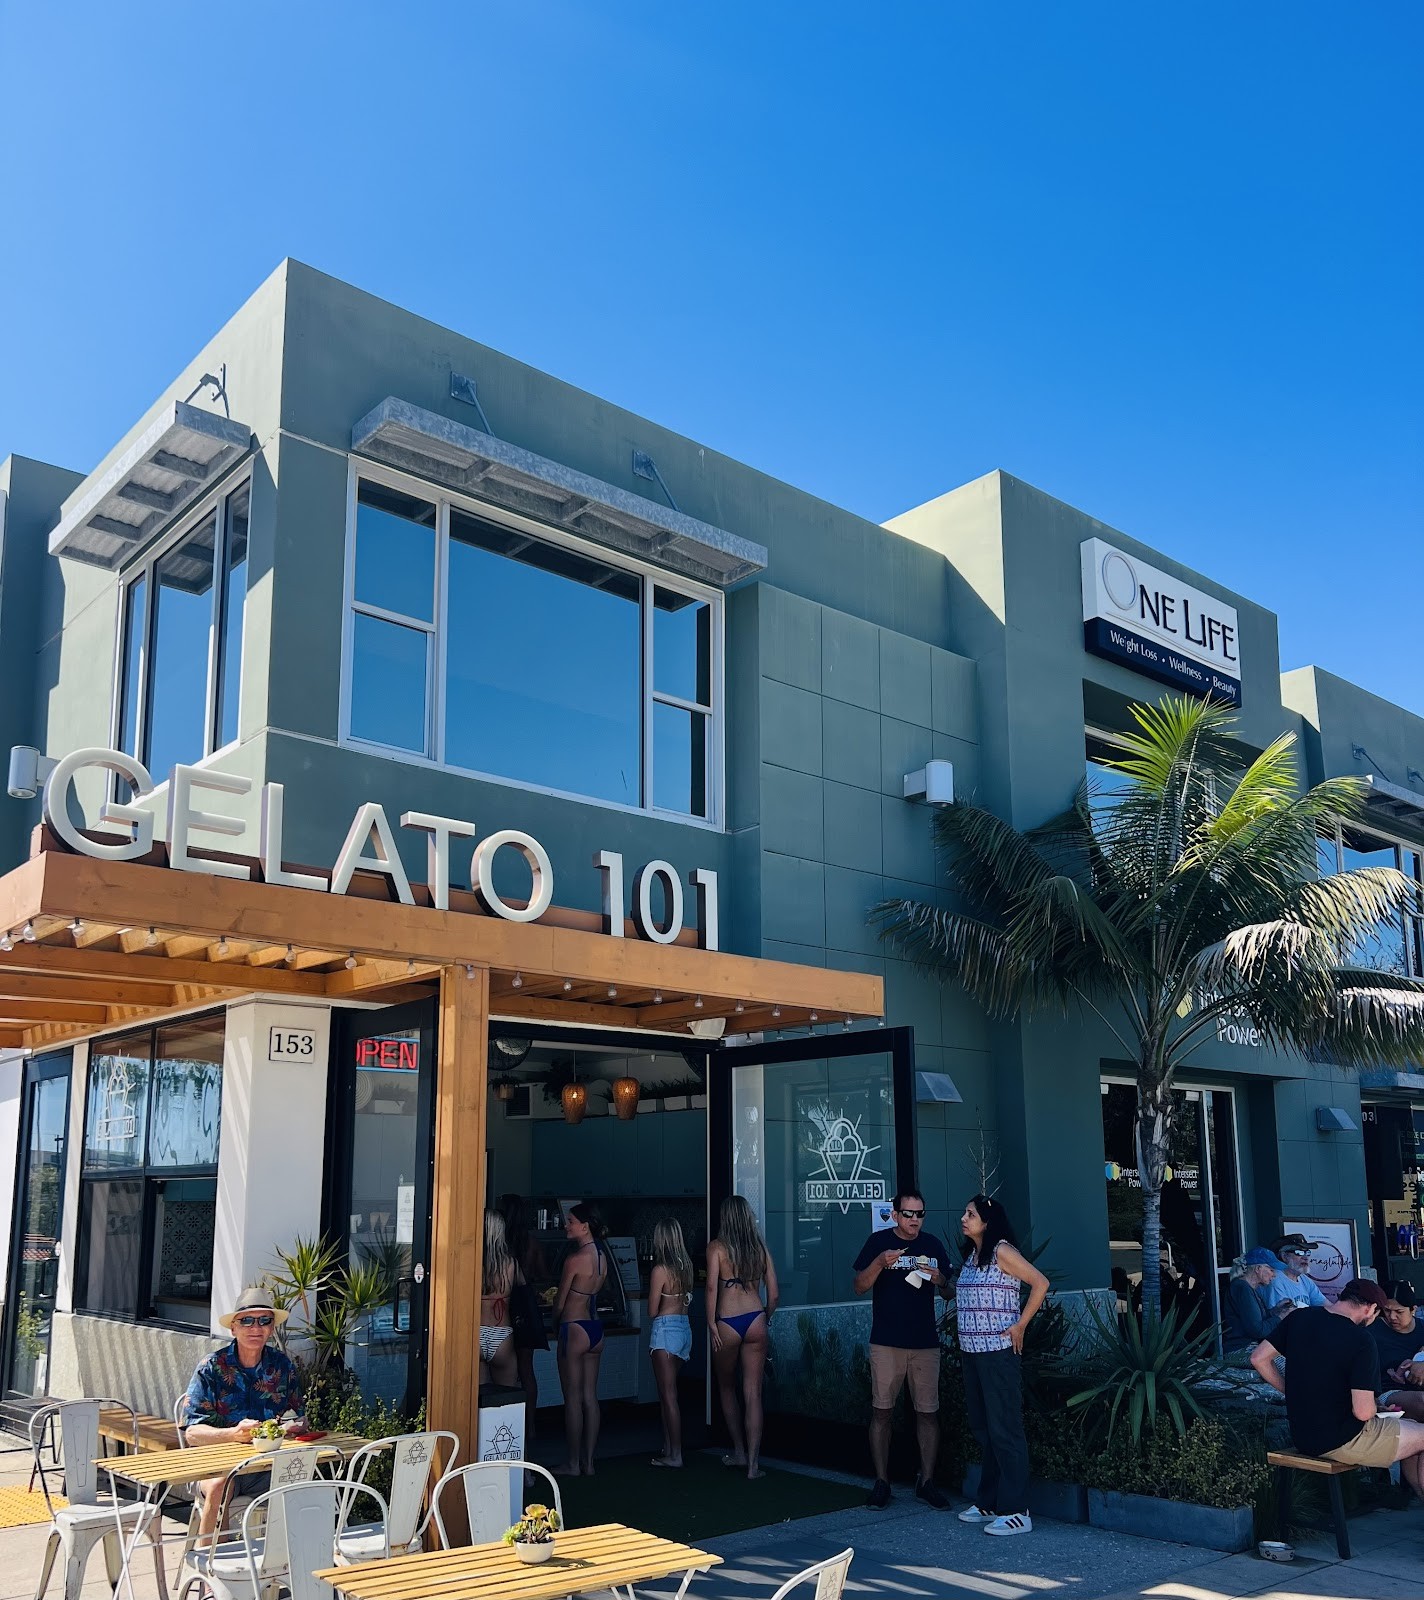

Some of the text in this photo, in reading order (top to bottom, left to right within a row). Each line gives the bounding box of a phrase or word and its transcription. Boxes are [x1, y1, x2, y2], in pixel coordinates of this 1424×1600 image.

[1102, 551, 1237, 662] ONE LIFE
[1109, 629, 1238, 698] Weight Loss Wellness Beauty
[43, 747, 720, 951] GELATO 101
[273, 1033, 313, 1055] 153
[1128, 1177, 1142, 1188] Pow
[1180, 1178, 1198, 1189] Power
